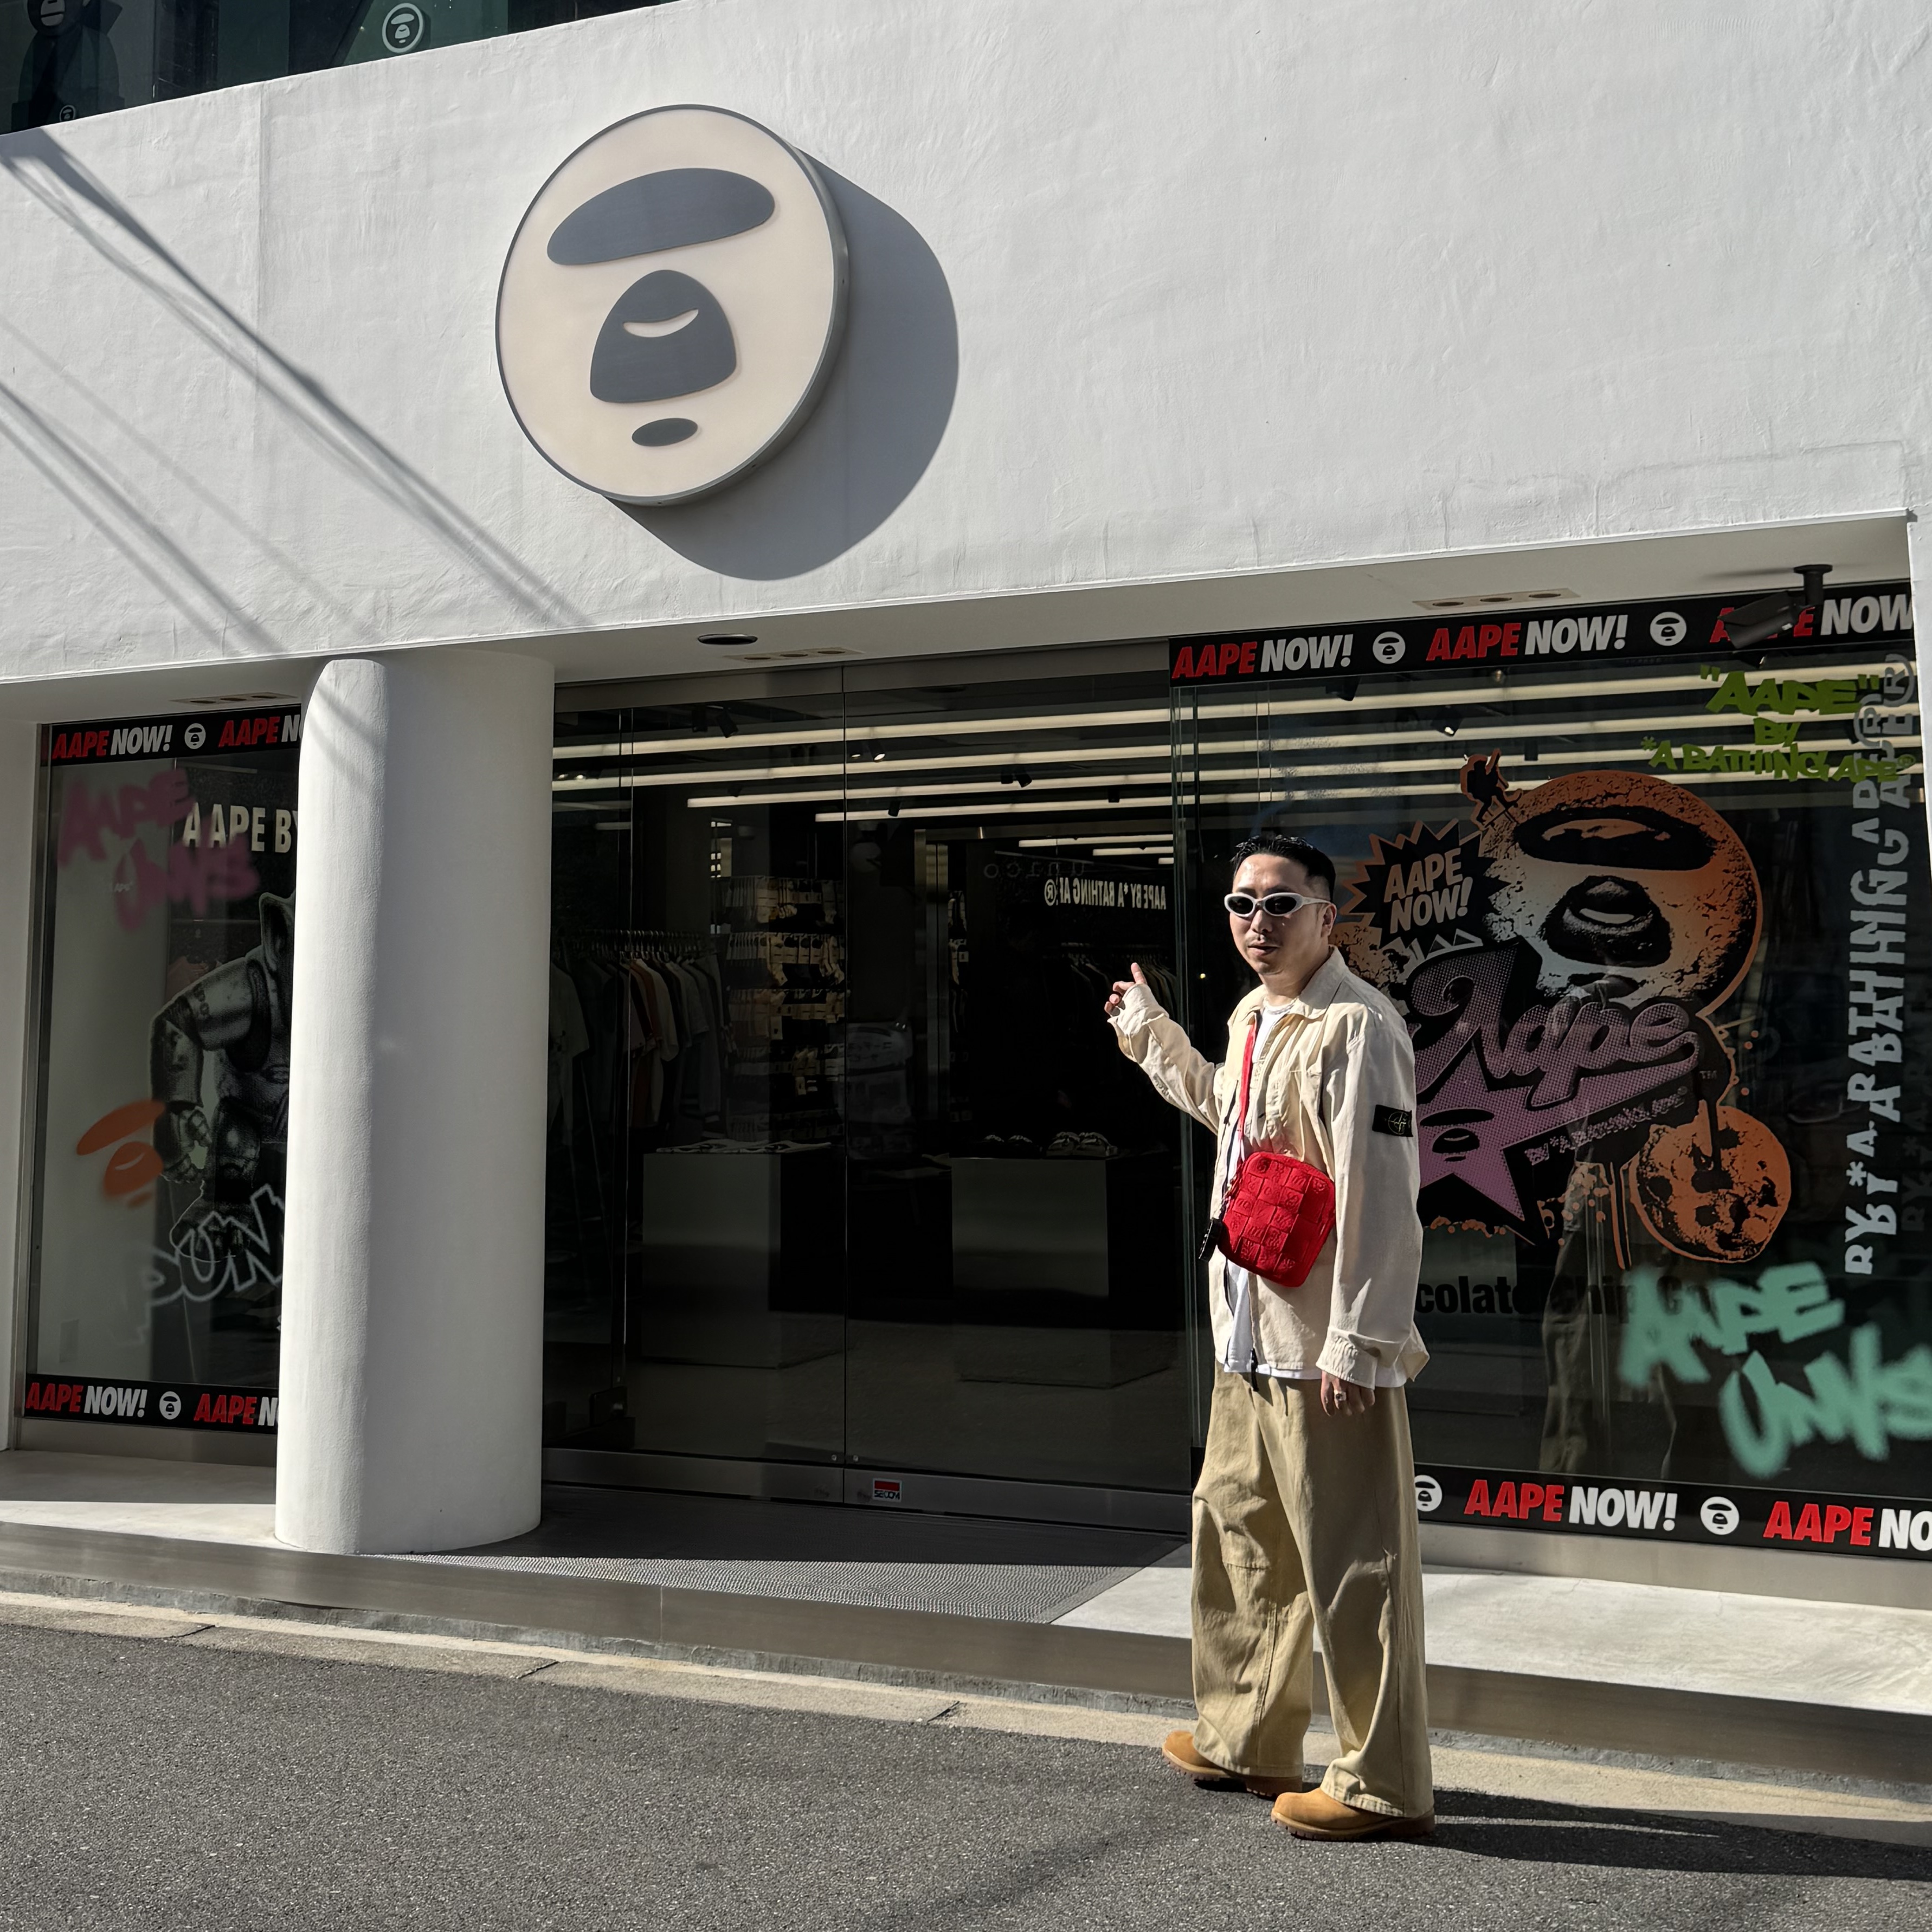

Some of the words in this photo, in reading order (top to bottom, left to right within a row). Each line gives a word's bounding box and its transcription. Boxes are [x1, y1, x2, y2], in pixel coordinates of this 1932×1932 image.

[1426, 623, 1521, 661] AAPE
[1524, 615, 1628, 655] NOW!
[1709, 607, 1815, 643] AE
[1171, 642, 1258, 679] AAPE
[1260, 634, 1353, 672] NOW!
[51, 731, 110, 759] AAPE
[110, 725, 173, 756] NOW!
[218, 715, 280, 748] AAPE
[281, 714, 302, 742] N
[1753, 717, 1801, 747] BY
[1682, 743, 1830, 782] BATHING
[274, 808, 299, 854] B
[1383, 848, 1463, 903] AAPE
[1390, 877, 1473, 934] NOW!
[25, 1382, 84, 1413] AAPE
[83, 1386, 147, 1418] NOW!
[194, 1393, 257, 1424] AAPE
[257, 1396, 279, 1426] N
[1464, 1479, 1564, 1522] AAPE
[1569, 1485, 1678, 1531] NOW!
[1763, 1500, 1873, 1546] AAPE
